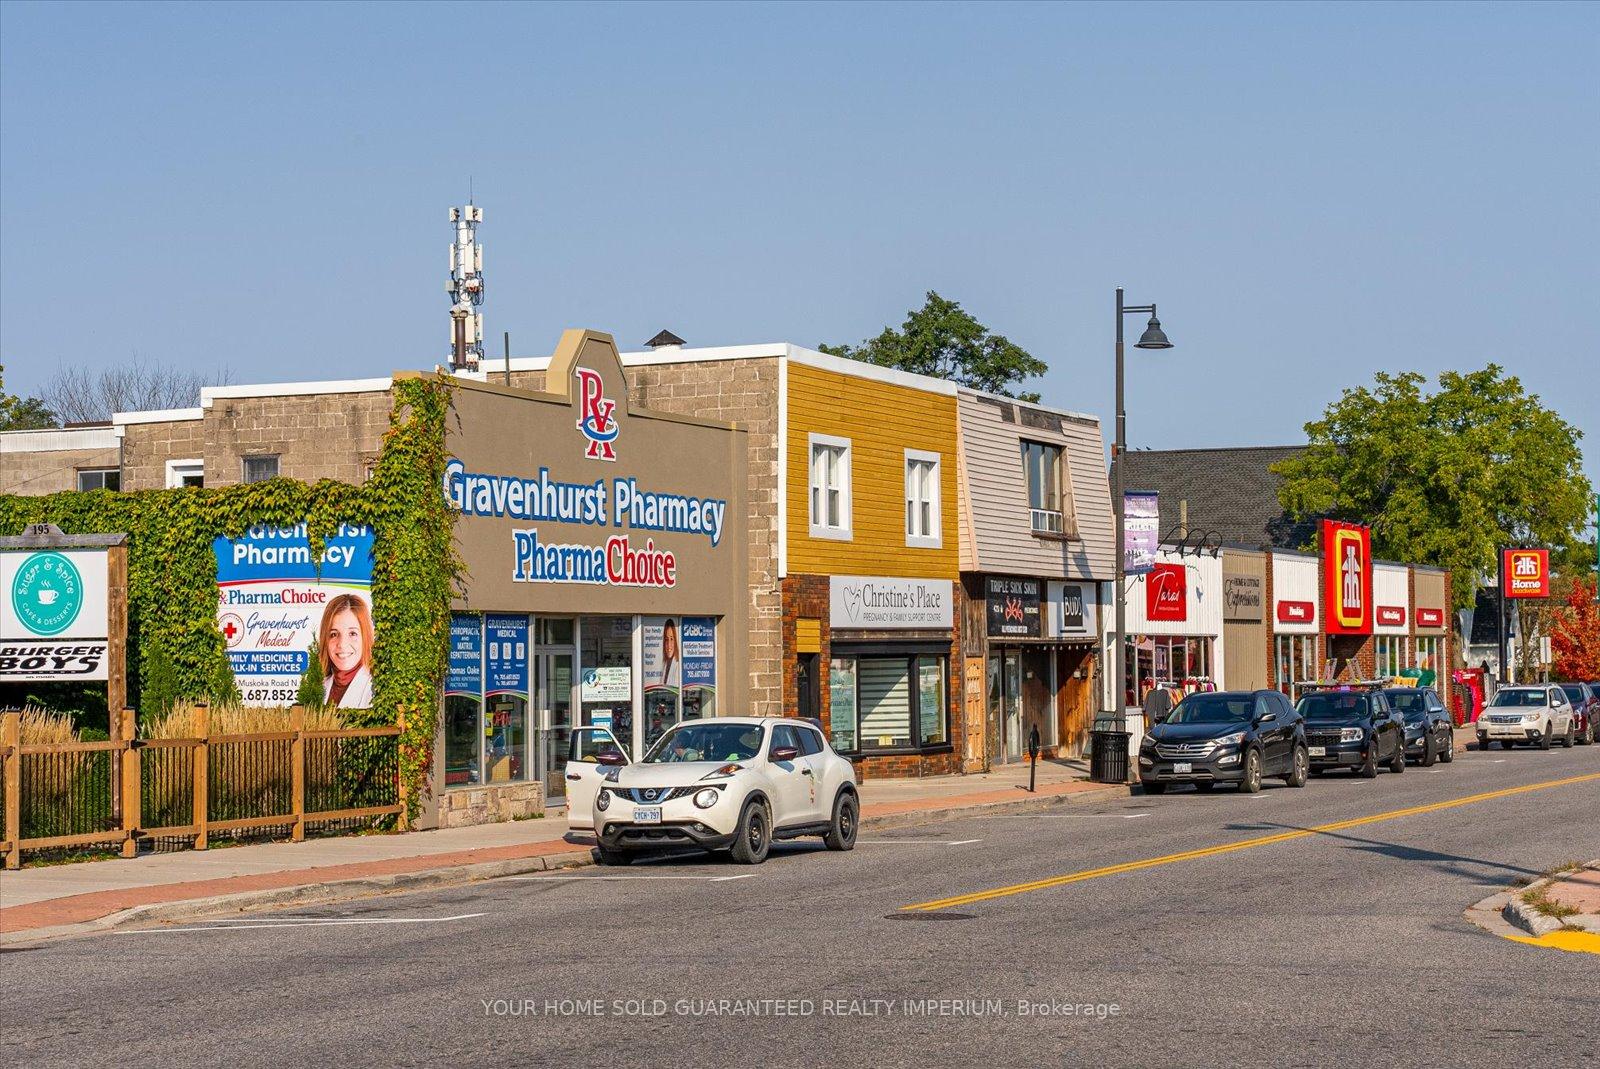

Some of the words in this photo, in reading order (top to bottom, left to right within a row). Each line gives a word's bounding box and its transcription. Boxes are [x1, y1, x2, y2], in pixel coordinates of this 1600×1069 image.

[443, 459, 607, 527] Gravenhurst
[613, 477, 726, 548] Pharmacy
[33, 524, 50, 536] 195
[512, 527, 676, 589] PharmaChoice
[18, 564, 40, 595] Sugar
[44, 558, 54, 571] &
[56, 563, 75, 594] Spice
[990, 579, 1009, 593] TRIPLE
[1512, 580, 1541, 589] Home
[229, 588, 326, 605] PharmaChoice
[862, 583, 915, 608] Christine's
[917, 585, 941, 608] Place
[44, 601, 73, 626] DESSERTS
[863, 612, 888, 622] PREGNANCY
[894, 613, 907, 622] FAMILY
[908, 613, 926, 622] SUPPORT
[246, 611, 309, 635] Gravenhurst
[487, 619, 526, 629] GRAVENHURST
[255, 630, 295, 648] Medical
[497, 629, 517, 638] MEDICAL
[0, 646, 106, 656] BURGER
[0, 656, 100, 674] BOYS
[229, 654, 248, 662] MILY
[251, 654, 293, 663] MEDICINE
[296, 654, 304, 663] &
[230, 664, 257, 672] ALK-IN
[261, 664, 301, 672] SERVICES
[238, 679, 269, 687] Muskoka
[271, 679, 289, 687] Road
